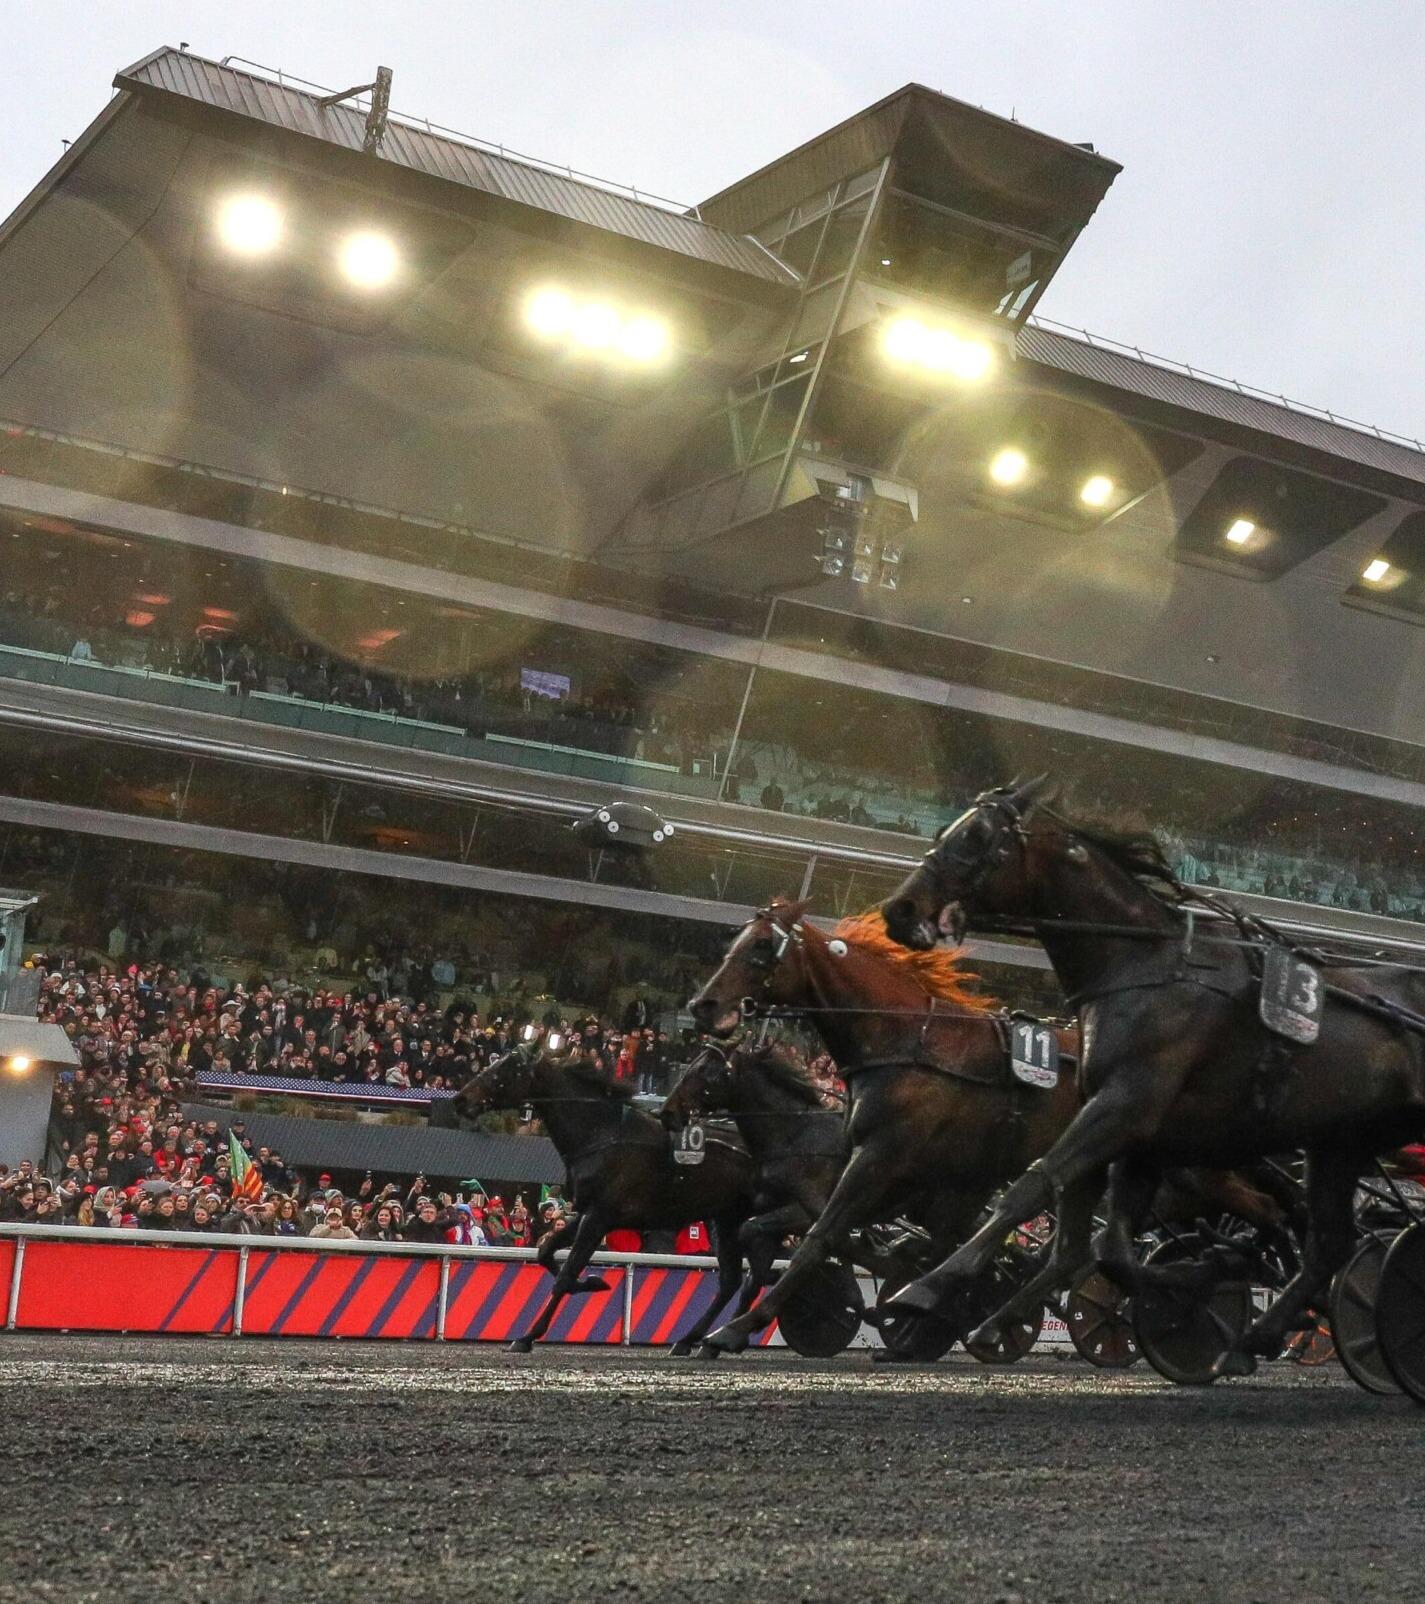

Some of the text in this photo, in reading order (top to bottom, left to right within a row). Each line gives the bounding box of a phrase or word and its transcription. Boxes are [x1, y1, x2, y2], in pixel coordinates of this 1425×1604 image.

[1019, 1025, 1051, 1068] 11
[681, 1126, 704, 1150] 10
[1040, 1320, 1069, 1330] EGEN
